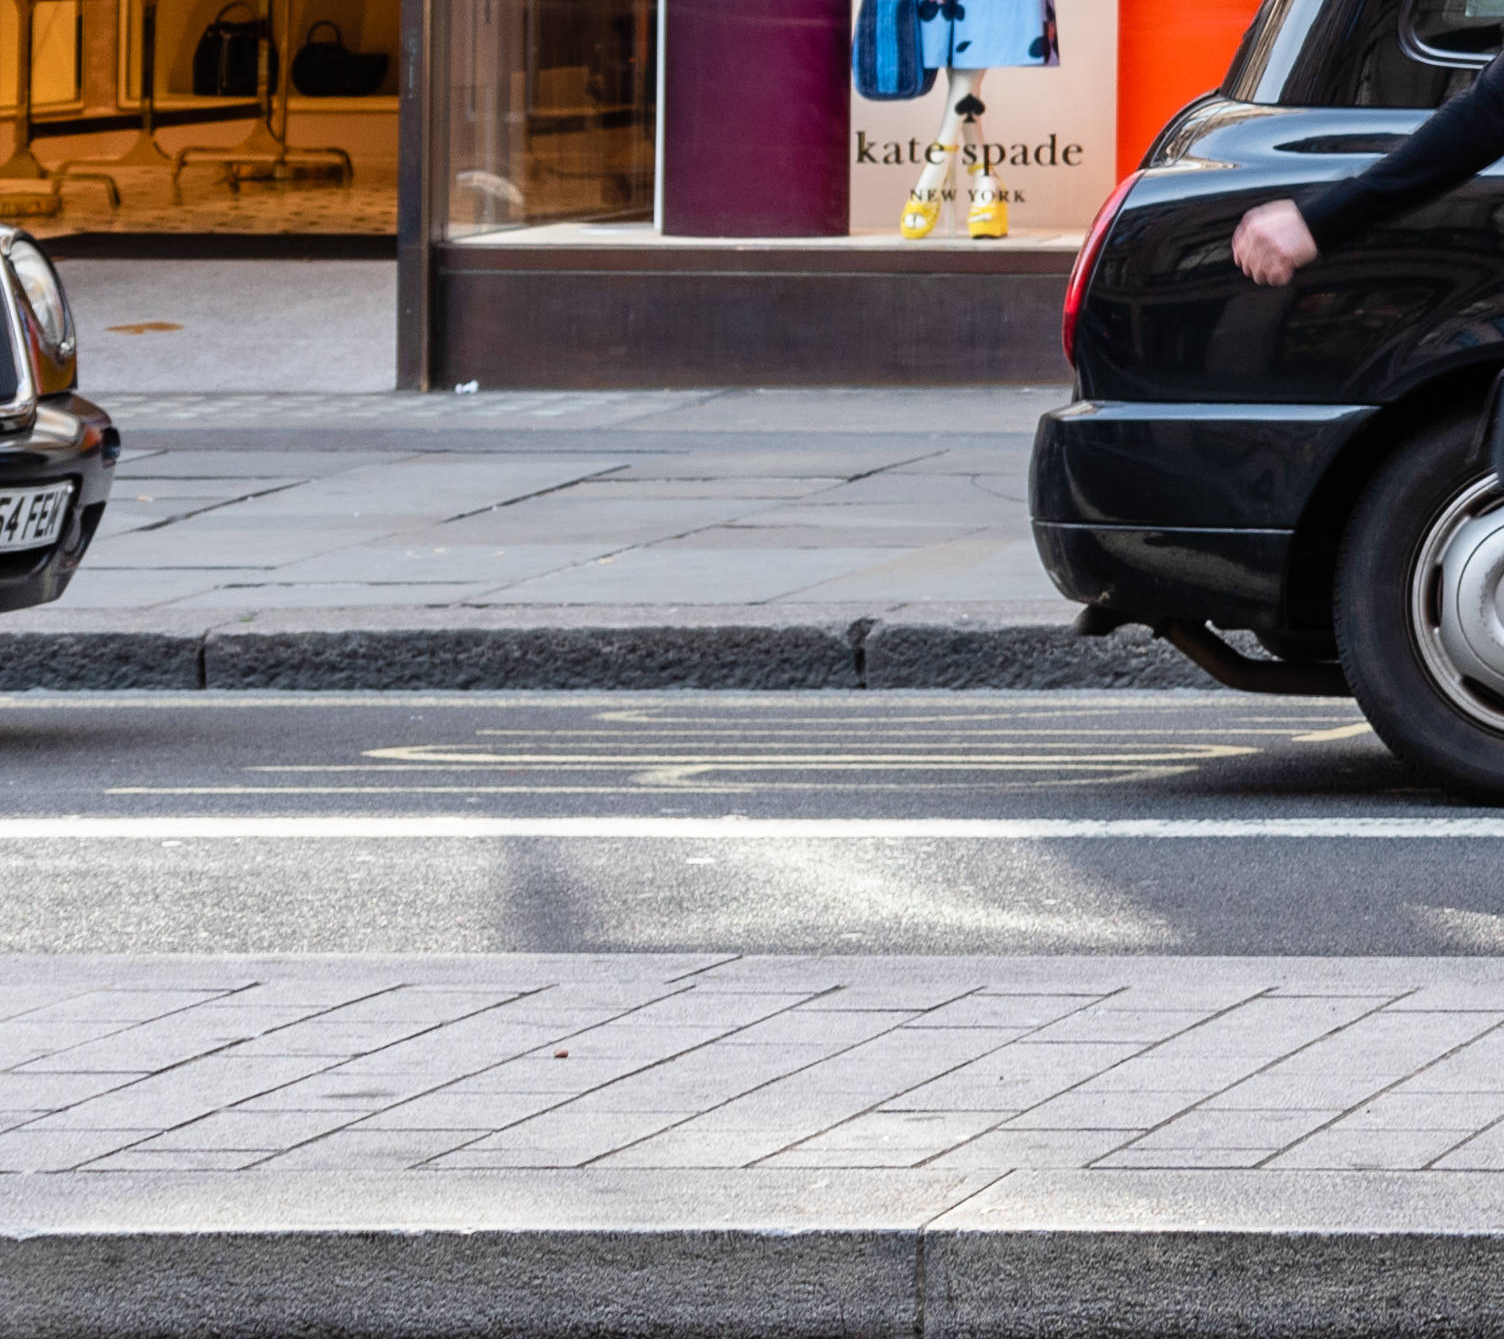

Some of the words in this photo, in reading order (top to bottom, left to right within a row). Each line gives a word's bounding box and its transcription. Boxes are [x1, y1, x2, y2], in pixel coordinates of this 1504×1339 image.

[856, 131, 946, 165] kate
[961, 134, 1084, 177] spade
[910, 188, 958, 203] NEW
[967, 188, 1027, 204] YORK
